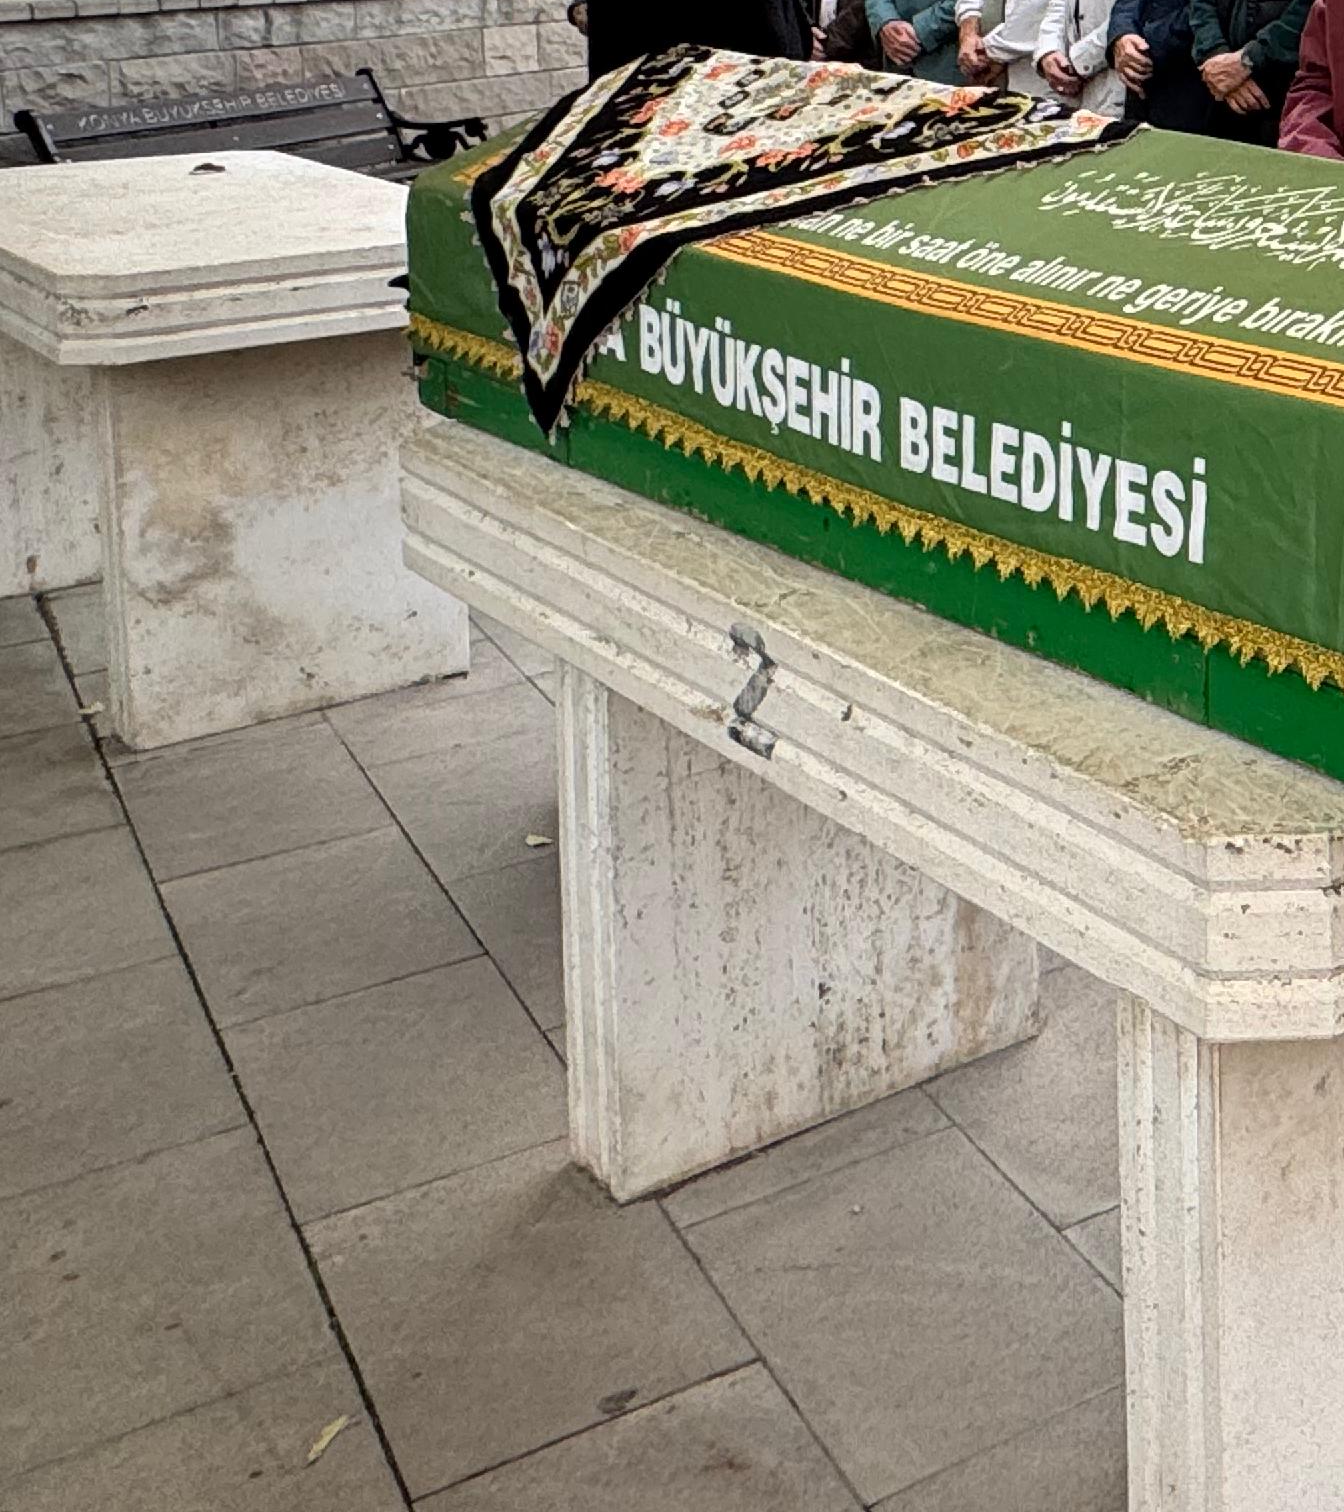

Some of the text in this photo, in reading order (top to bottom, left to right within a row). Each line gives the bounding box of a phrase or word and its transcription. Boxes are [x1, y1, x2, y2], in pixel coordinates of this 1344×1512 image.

[861, 220, 915, 249] bir
[898, 233, 977, 264] saat
[956, 241, 1021, 276] öne
[1009, 256, 1103, 292] alınır
[1086, 275, 1143, 301] ne
[1122, 284, 1249, 326] geriye
[638, 297, 1208, 564] BÜYÜKŞEHİR BELEDİYESİ
